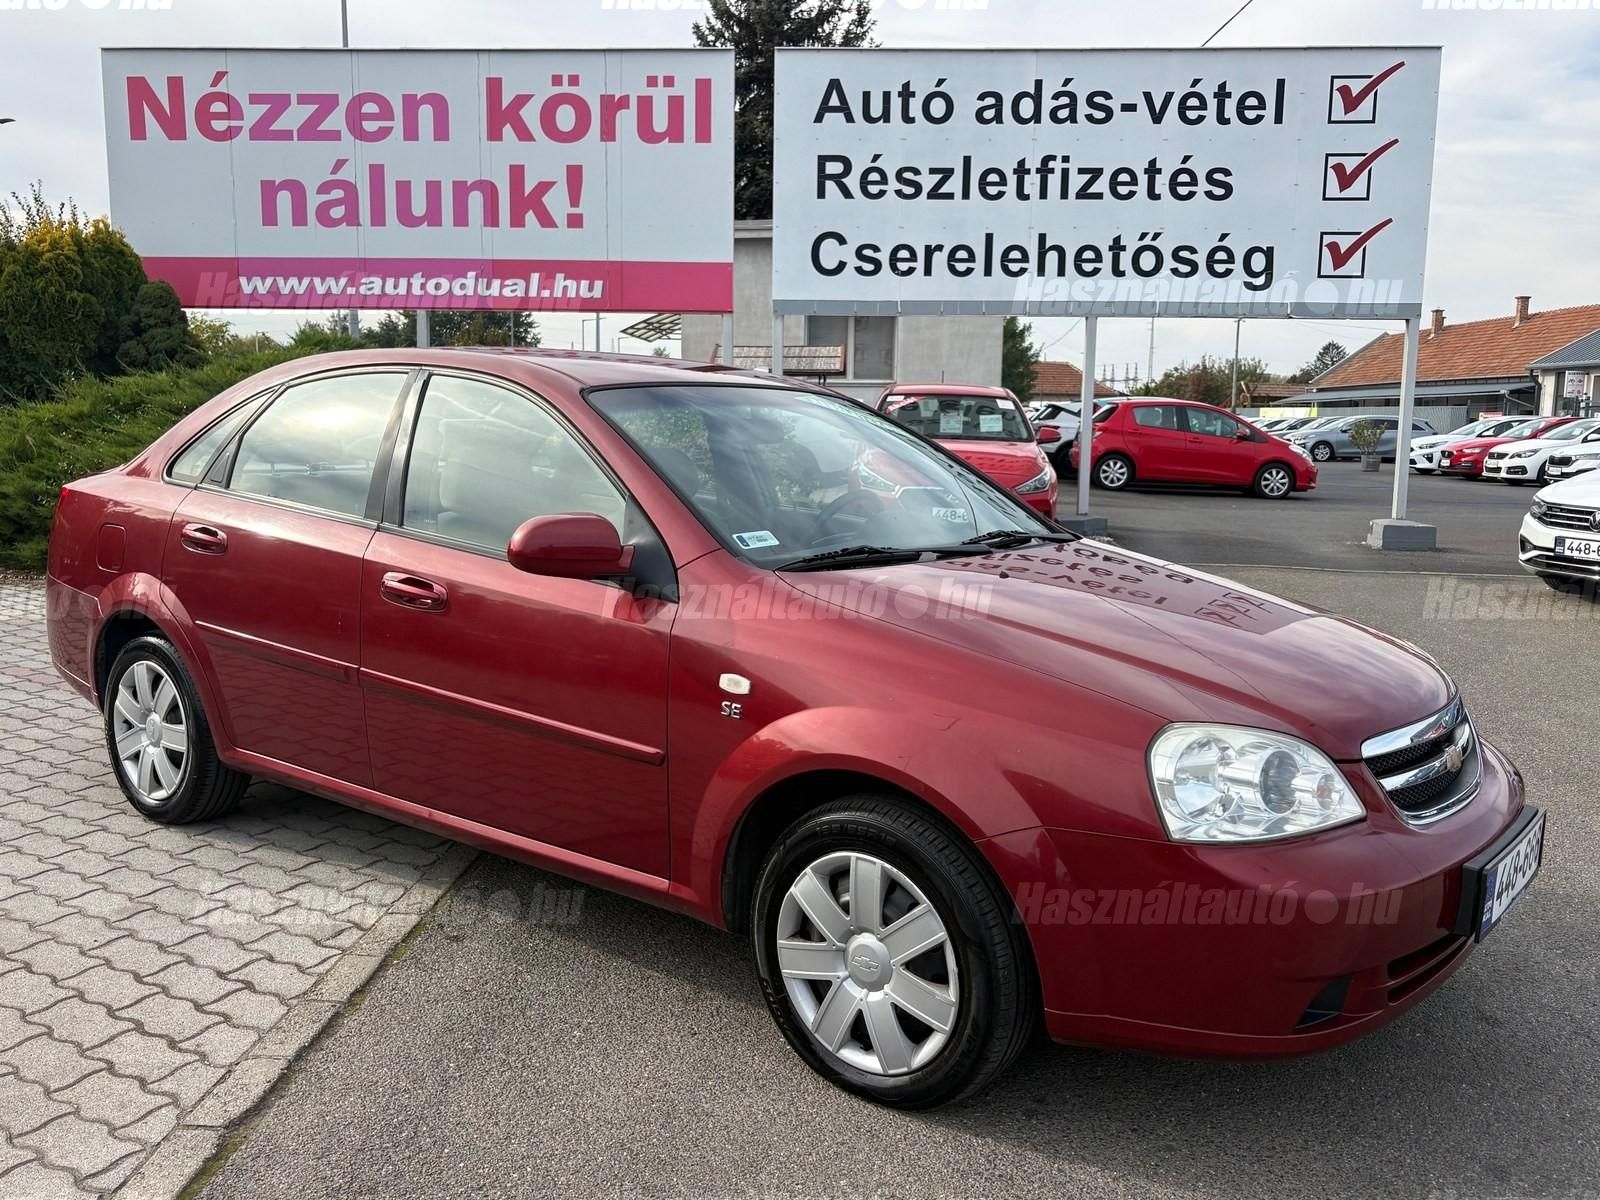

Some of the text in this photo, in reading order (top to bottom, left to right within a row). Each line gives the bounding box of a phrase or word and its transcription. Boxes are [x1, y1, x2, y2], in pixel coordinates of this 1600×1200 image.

[127, 71, 712, 145] Nézzen körül
[813, 77, 1286, 126] Autó adás-vétel
[261, 160, 583, 229] nálunk!
[816, 153, 1234, 202] Részletfizetés
[238, 271, 604, 299] www.autodual.hu
[810, 231, 1275, 292] Cserelehetőség
[720, 700, 742, 719] SE
